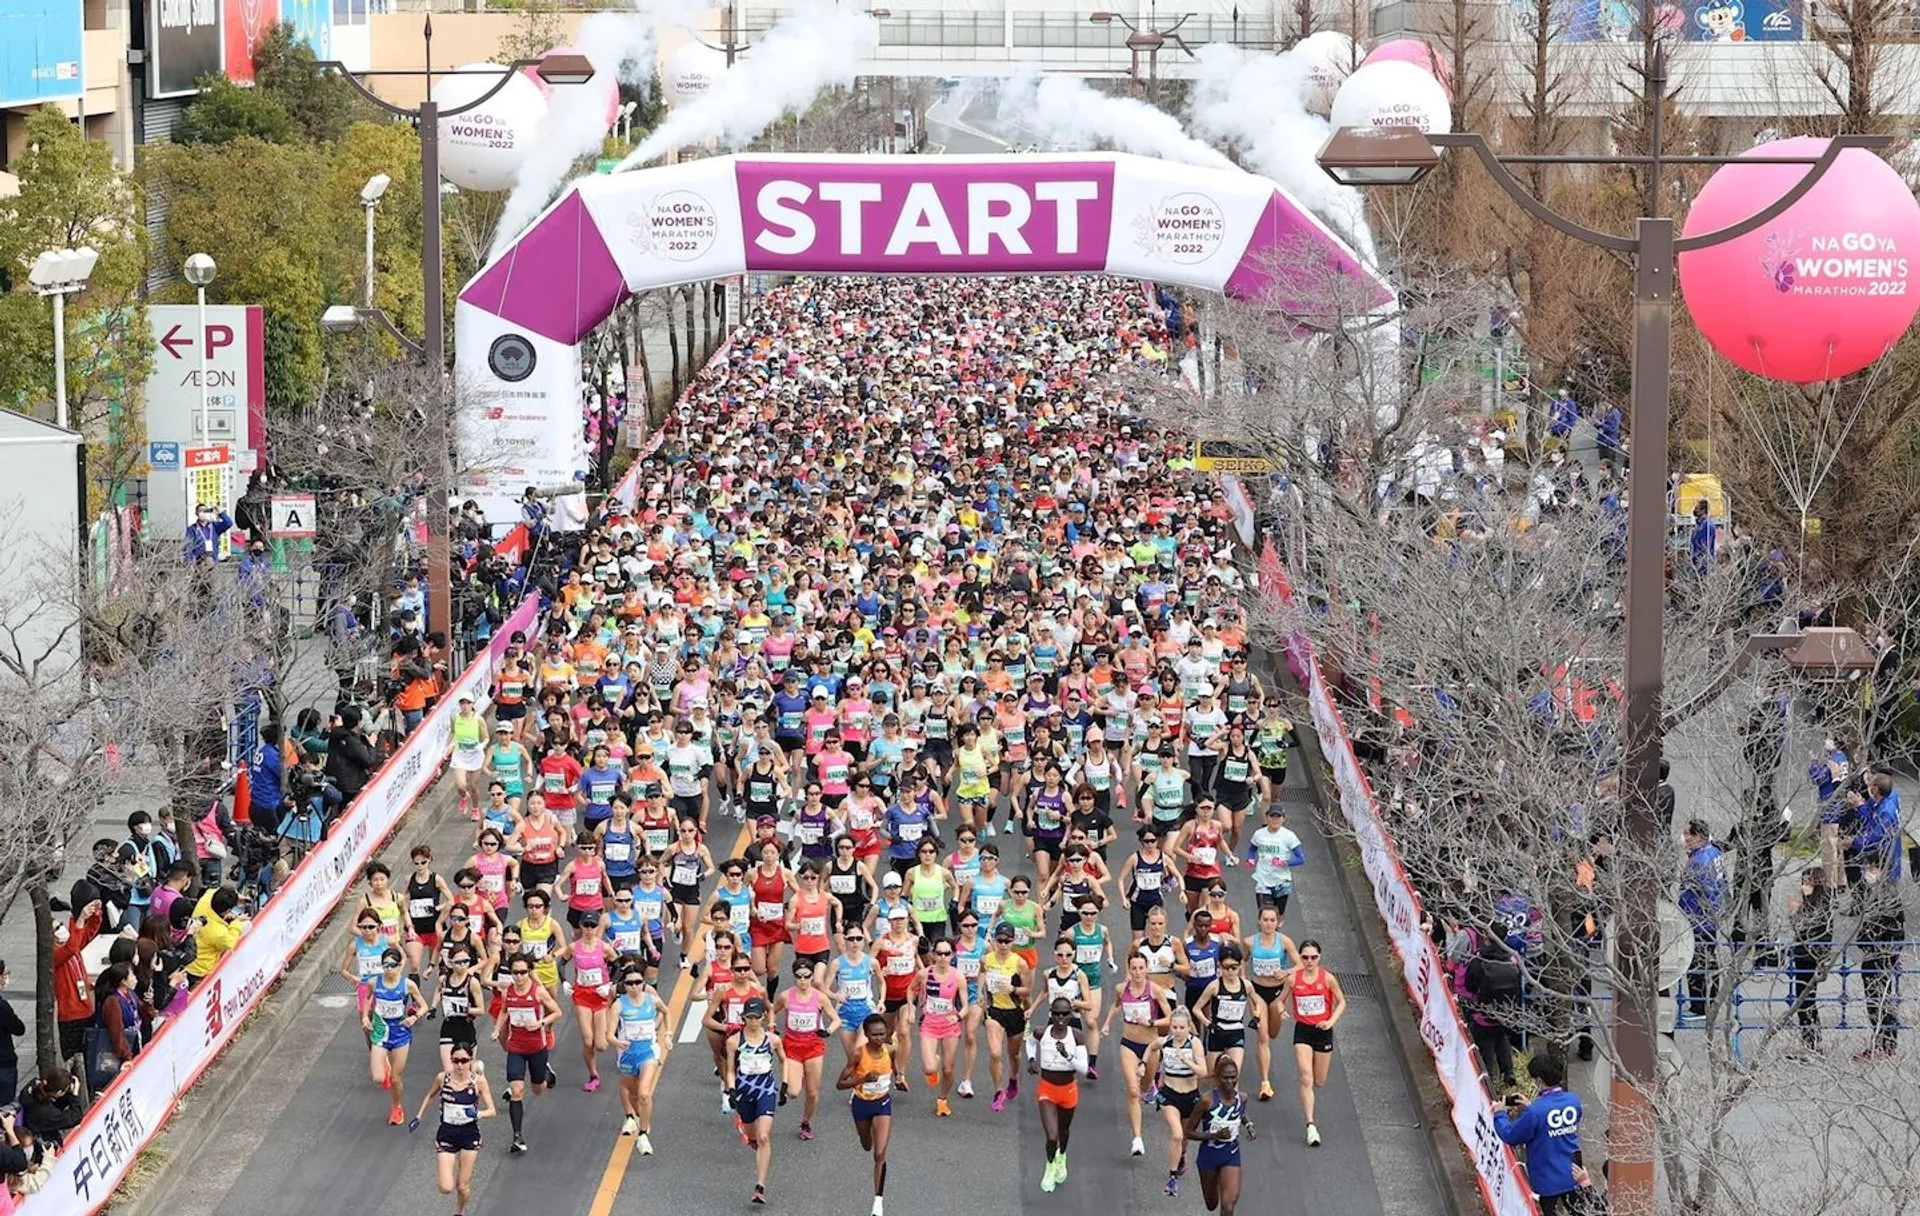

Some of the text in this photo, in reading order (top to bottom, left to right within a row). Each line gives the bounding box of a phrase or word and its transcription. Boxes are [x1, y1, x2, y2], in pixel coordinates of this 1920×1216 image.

[1371, 114, 1430, 127] WOMEN'S
[451, 125, 514, 140] WOMEN'S
[488, 140, 514, 149] 2022
[651, 216, 715, 227] WOMEN'S
[754, 179, 1099, 255] START
[1157, 218, 1222, 230] WOMEN'S
[652, 230, 714, 238] MARATHON
[1157, 232, 1220, 241] MARATHON
[669, 241, 698, 250] 2022
[1173, 244, 1203, 253] 2022
[1795, 257, 1908, 278] WOMEN'S
[1793, 281, 1907, 296] MARATHON 2022
[205, 325, 234, 360] P
[1213, 460, 1266, 471] SEIKO
[285, 510, 302, 527] A
[223, 968, 264, 1022] new balance
[795, 1018, 811, 1026] 107
[1547, 1106, 1578, 1129] GO
[73, 1088, 144, 1202] 中日新聞
